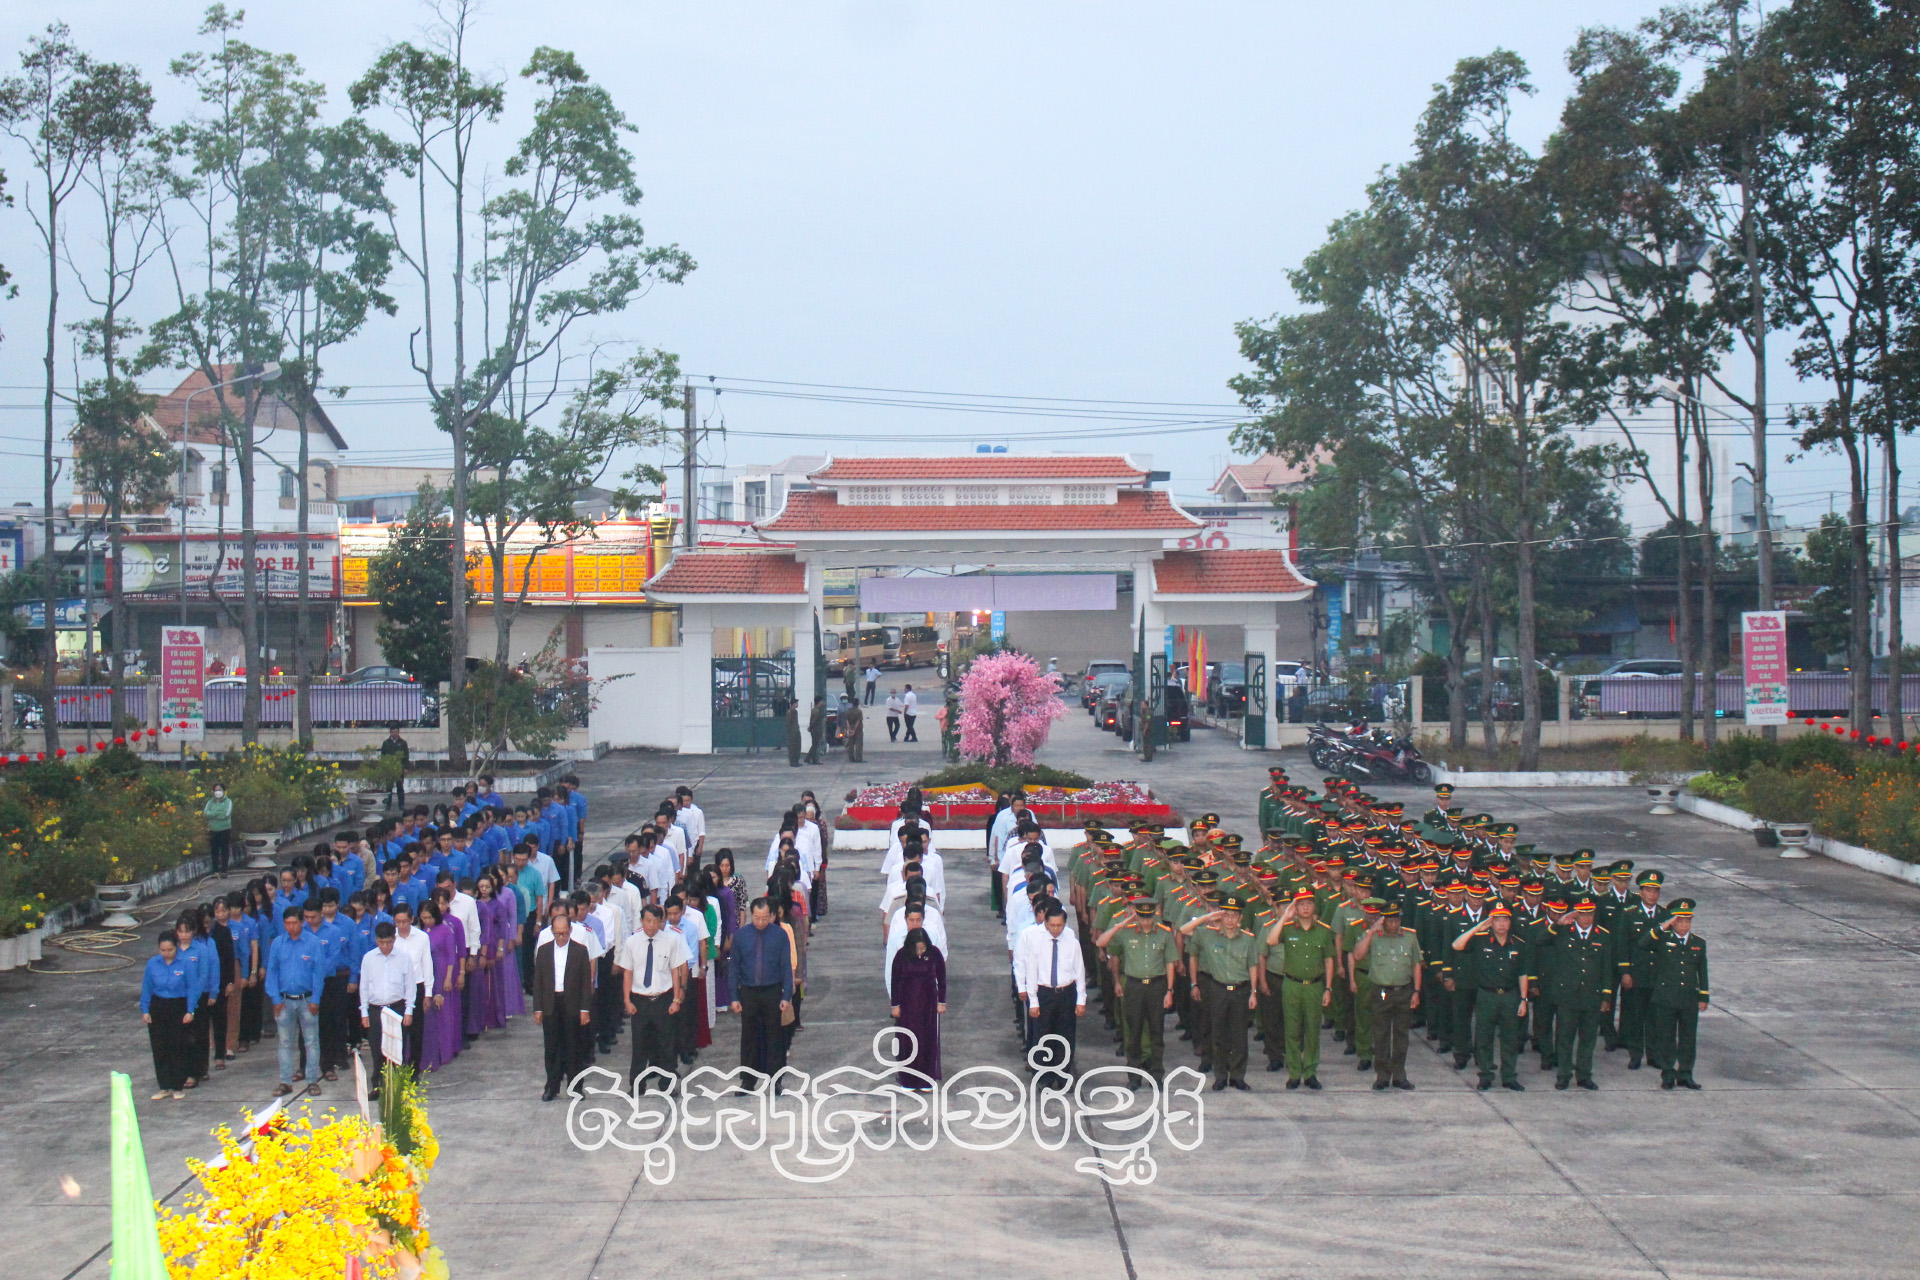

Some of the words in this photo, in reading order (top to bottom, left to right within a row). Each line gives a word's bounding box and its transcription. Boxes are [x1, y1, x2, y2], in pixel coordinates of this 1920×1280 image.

[270, 543, 278, 552] VỤ
[311, 543, 324, 551] MẠI
[1750, 706, 1782, 714] viettel
